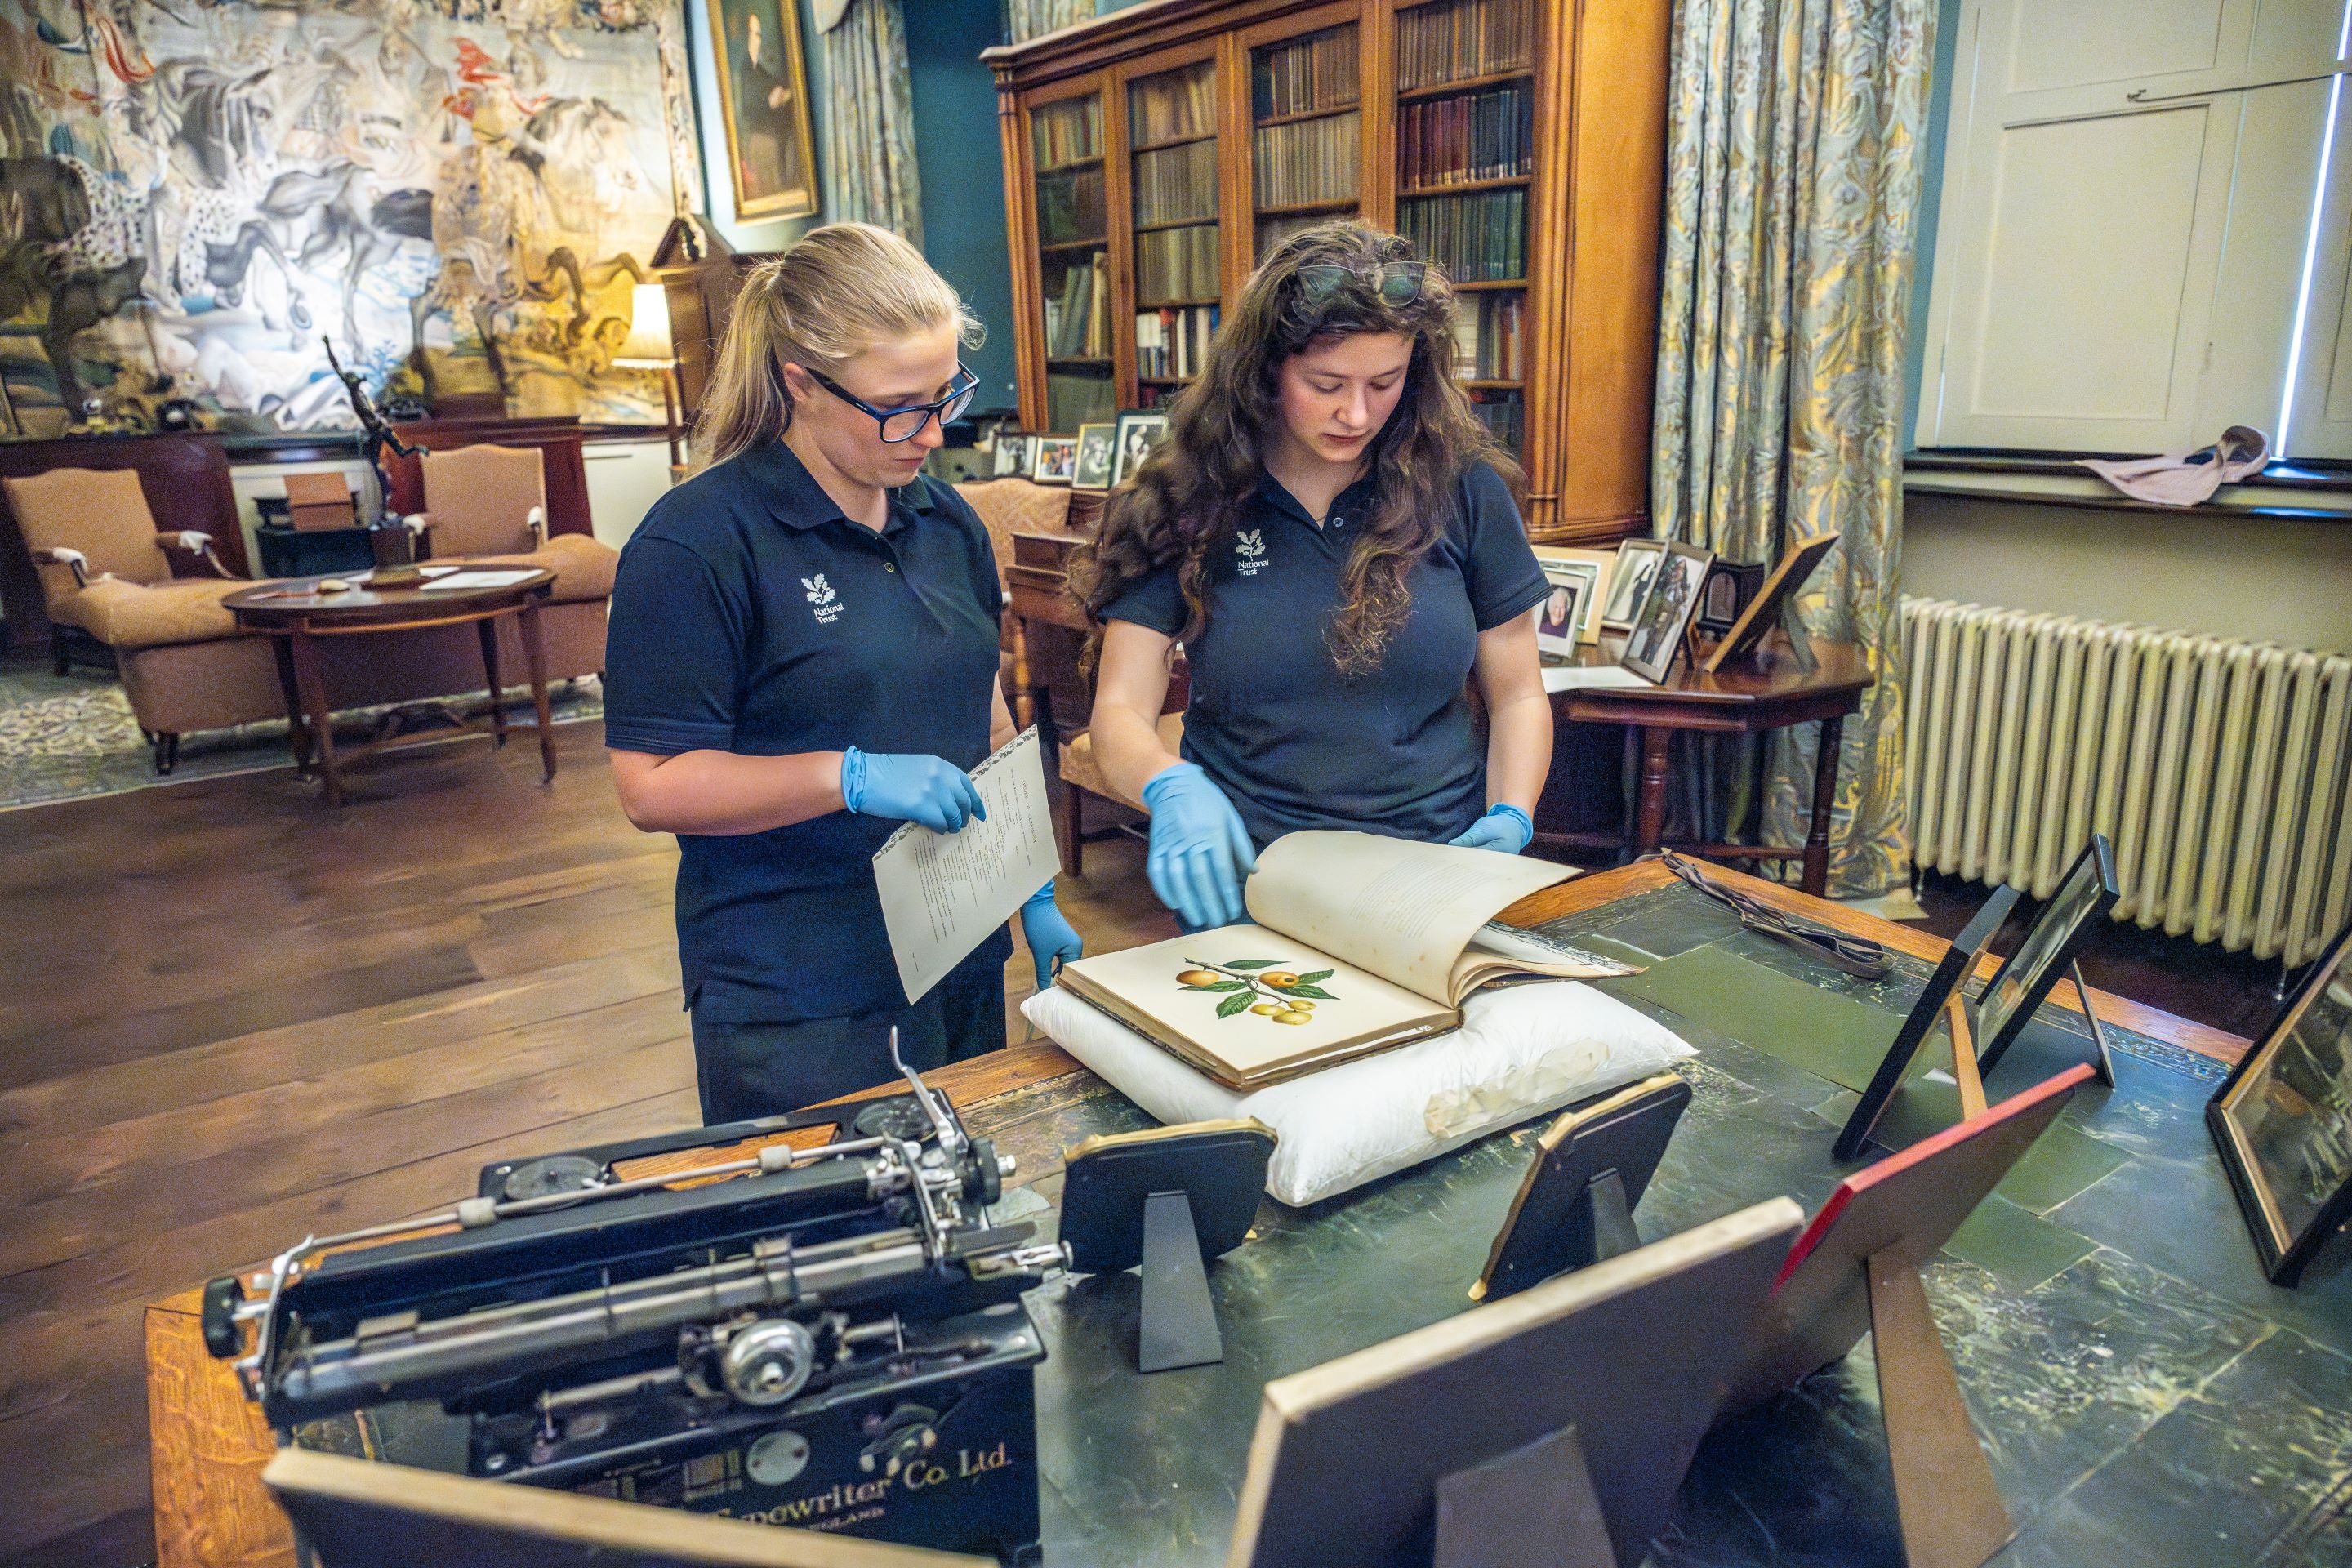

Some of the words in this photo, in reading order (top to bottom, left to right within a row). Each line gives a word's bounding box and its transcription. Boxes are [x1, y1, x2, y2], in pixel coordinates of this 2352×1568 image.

[1237, 558, 1269, 568] National
[1237, 568, 1258, 576] Trust
[813, 602, 844, 618] National
[816, 613, 838, 624] Trust
[709, 1479, 893, 1525] pewriter
[958, 1441, 1012, 1478] Ltd.
[808, 1507, 885, 1530] NGLAND
